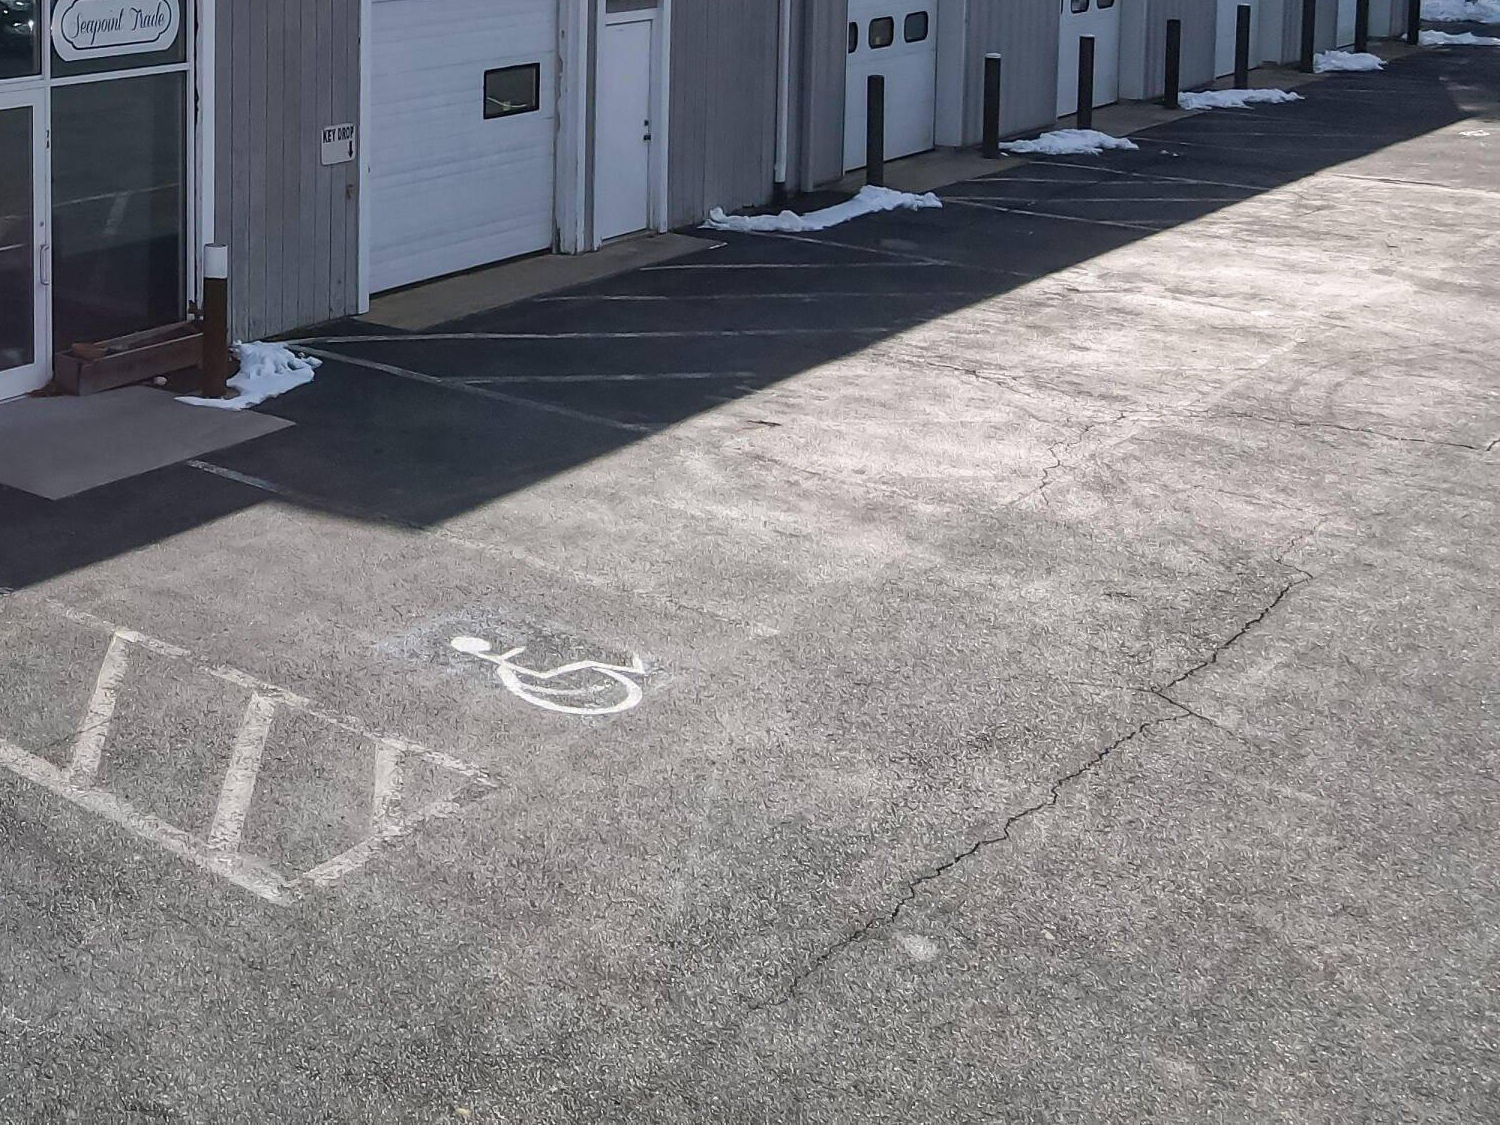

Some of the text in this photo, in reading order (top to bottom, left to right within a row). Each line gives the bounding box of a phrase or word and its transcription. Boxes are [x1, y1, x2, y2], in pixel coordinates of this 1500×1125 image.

[131, 2, 165, 30] Trade
[323, 126, 354, 143] KEY DROP
